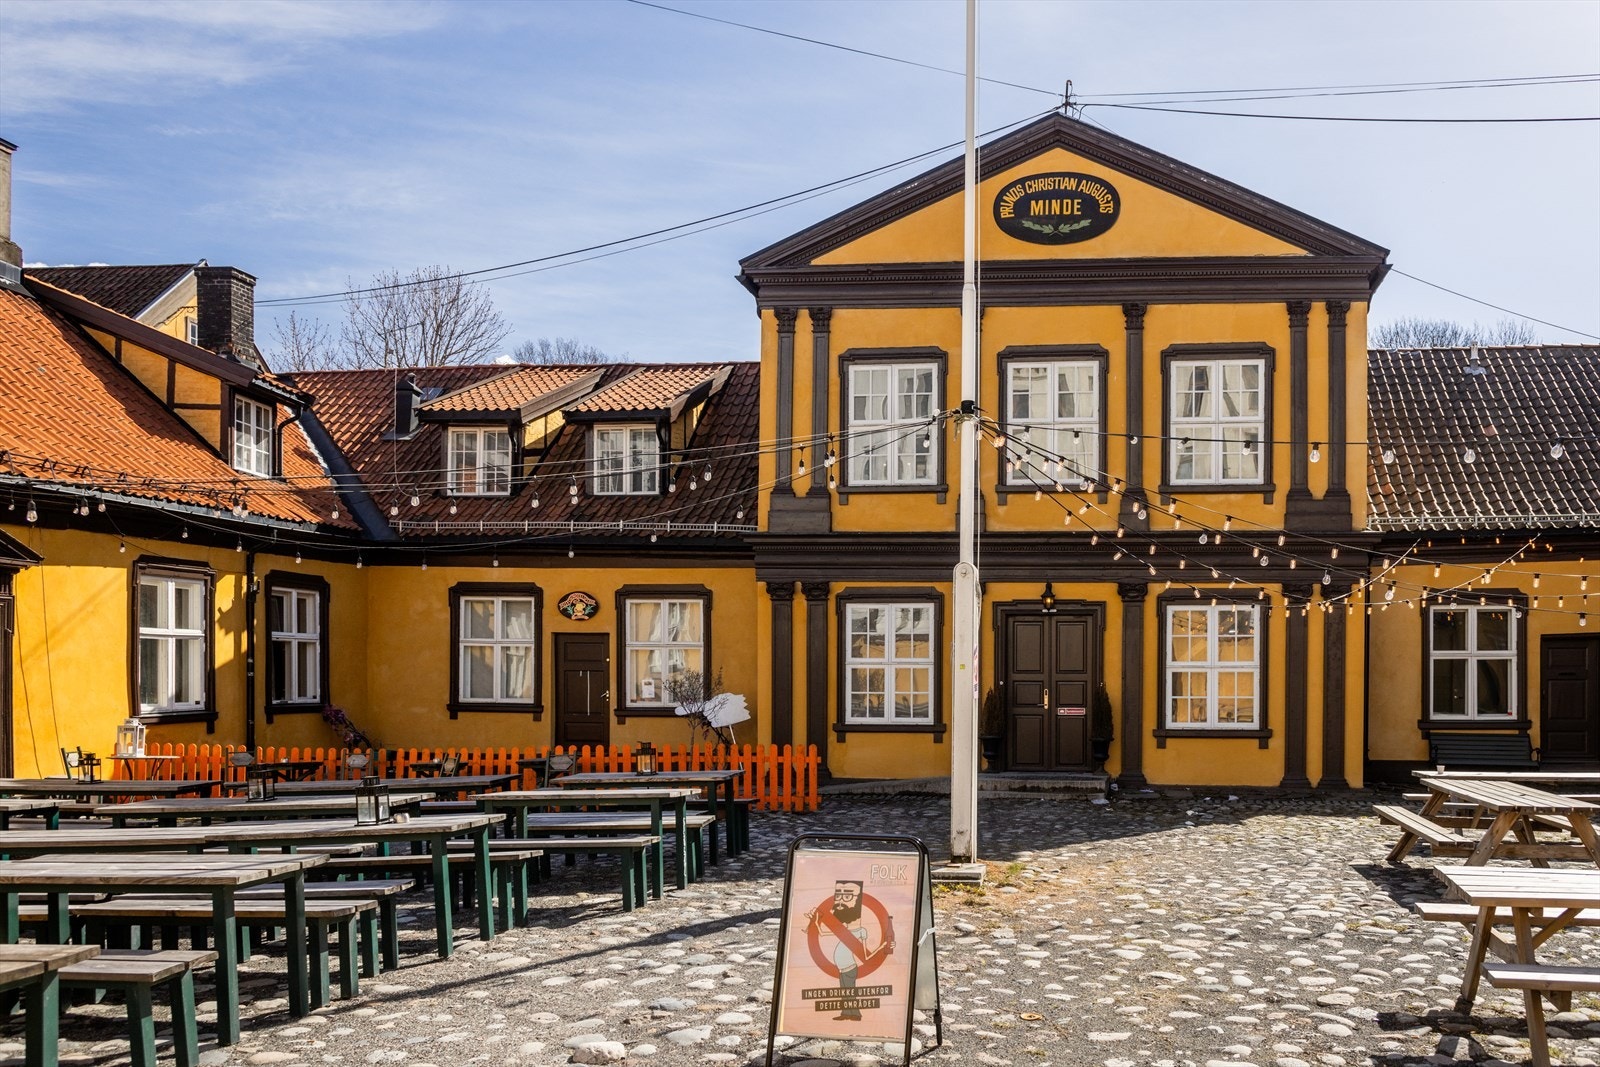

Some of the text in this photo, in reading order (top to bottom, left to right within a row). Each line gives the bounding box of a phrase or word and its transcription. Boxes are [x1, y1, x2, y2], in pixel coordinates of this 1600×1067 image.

[1000, 177, 1114, 218] PRINDS CHRISTIAN AUGUSTS
[1030, 199, 1082, 216] MINDE
[870, 863, 908, 881] FOLK
[805, 986, 889, 998] INGEN DRIKKE UTENFOR
[820, 1000, 876, 1010] DETTE OMRÅDET
